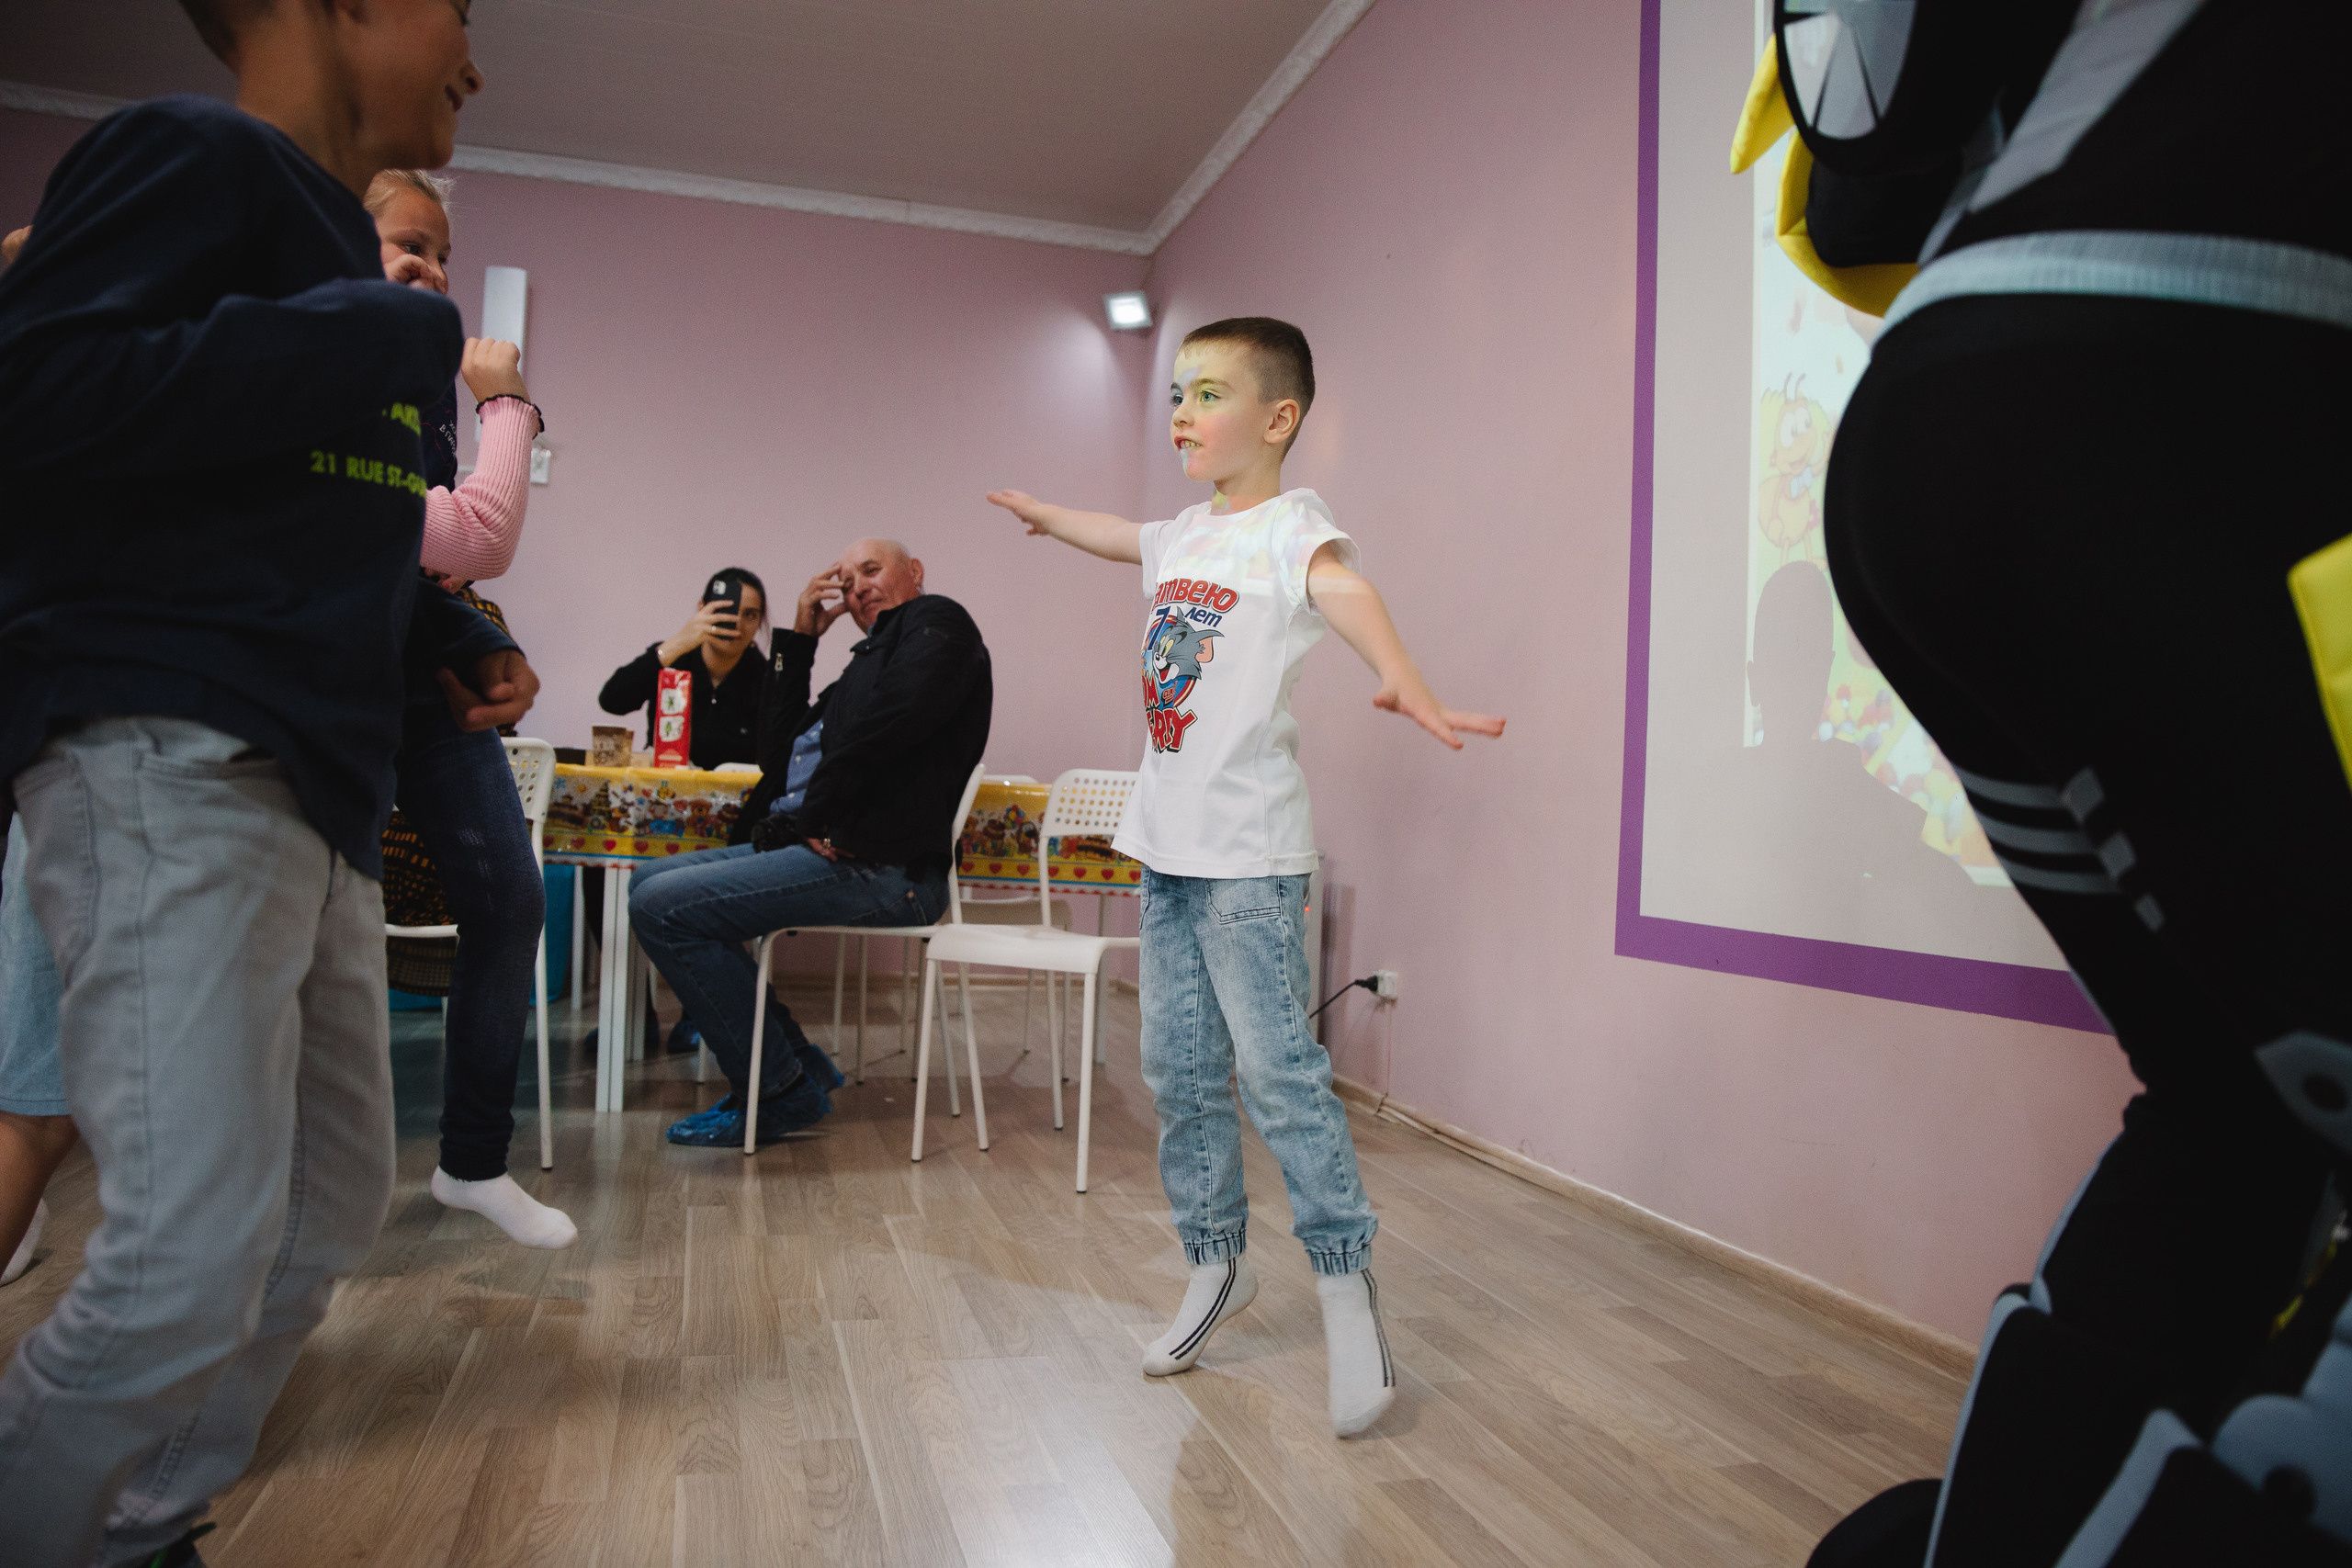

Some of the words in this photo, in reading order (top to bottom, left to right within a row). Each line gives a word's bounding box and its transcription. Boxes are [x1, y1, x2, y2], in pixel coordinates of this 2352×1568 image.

[311, 450, 336, 474] 21
[346, 456, 384, 484] RUE
[1148, 605, 1171, 651] 7
